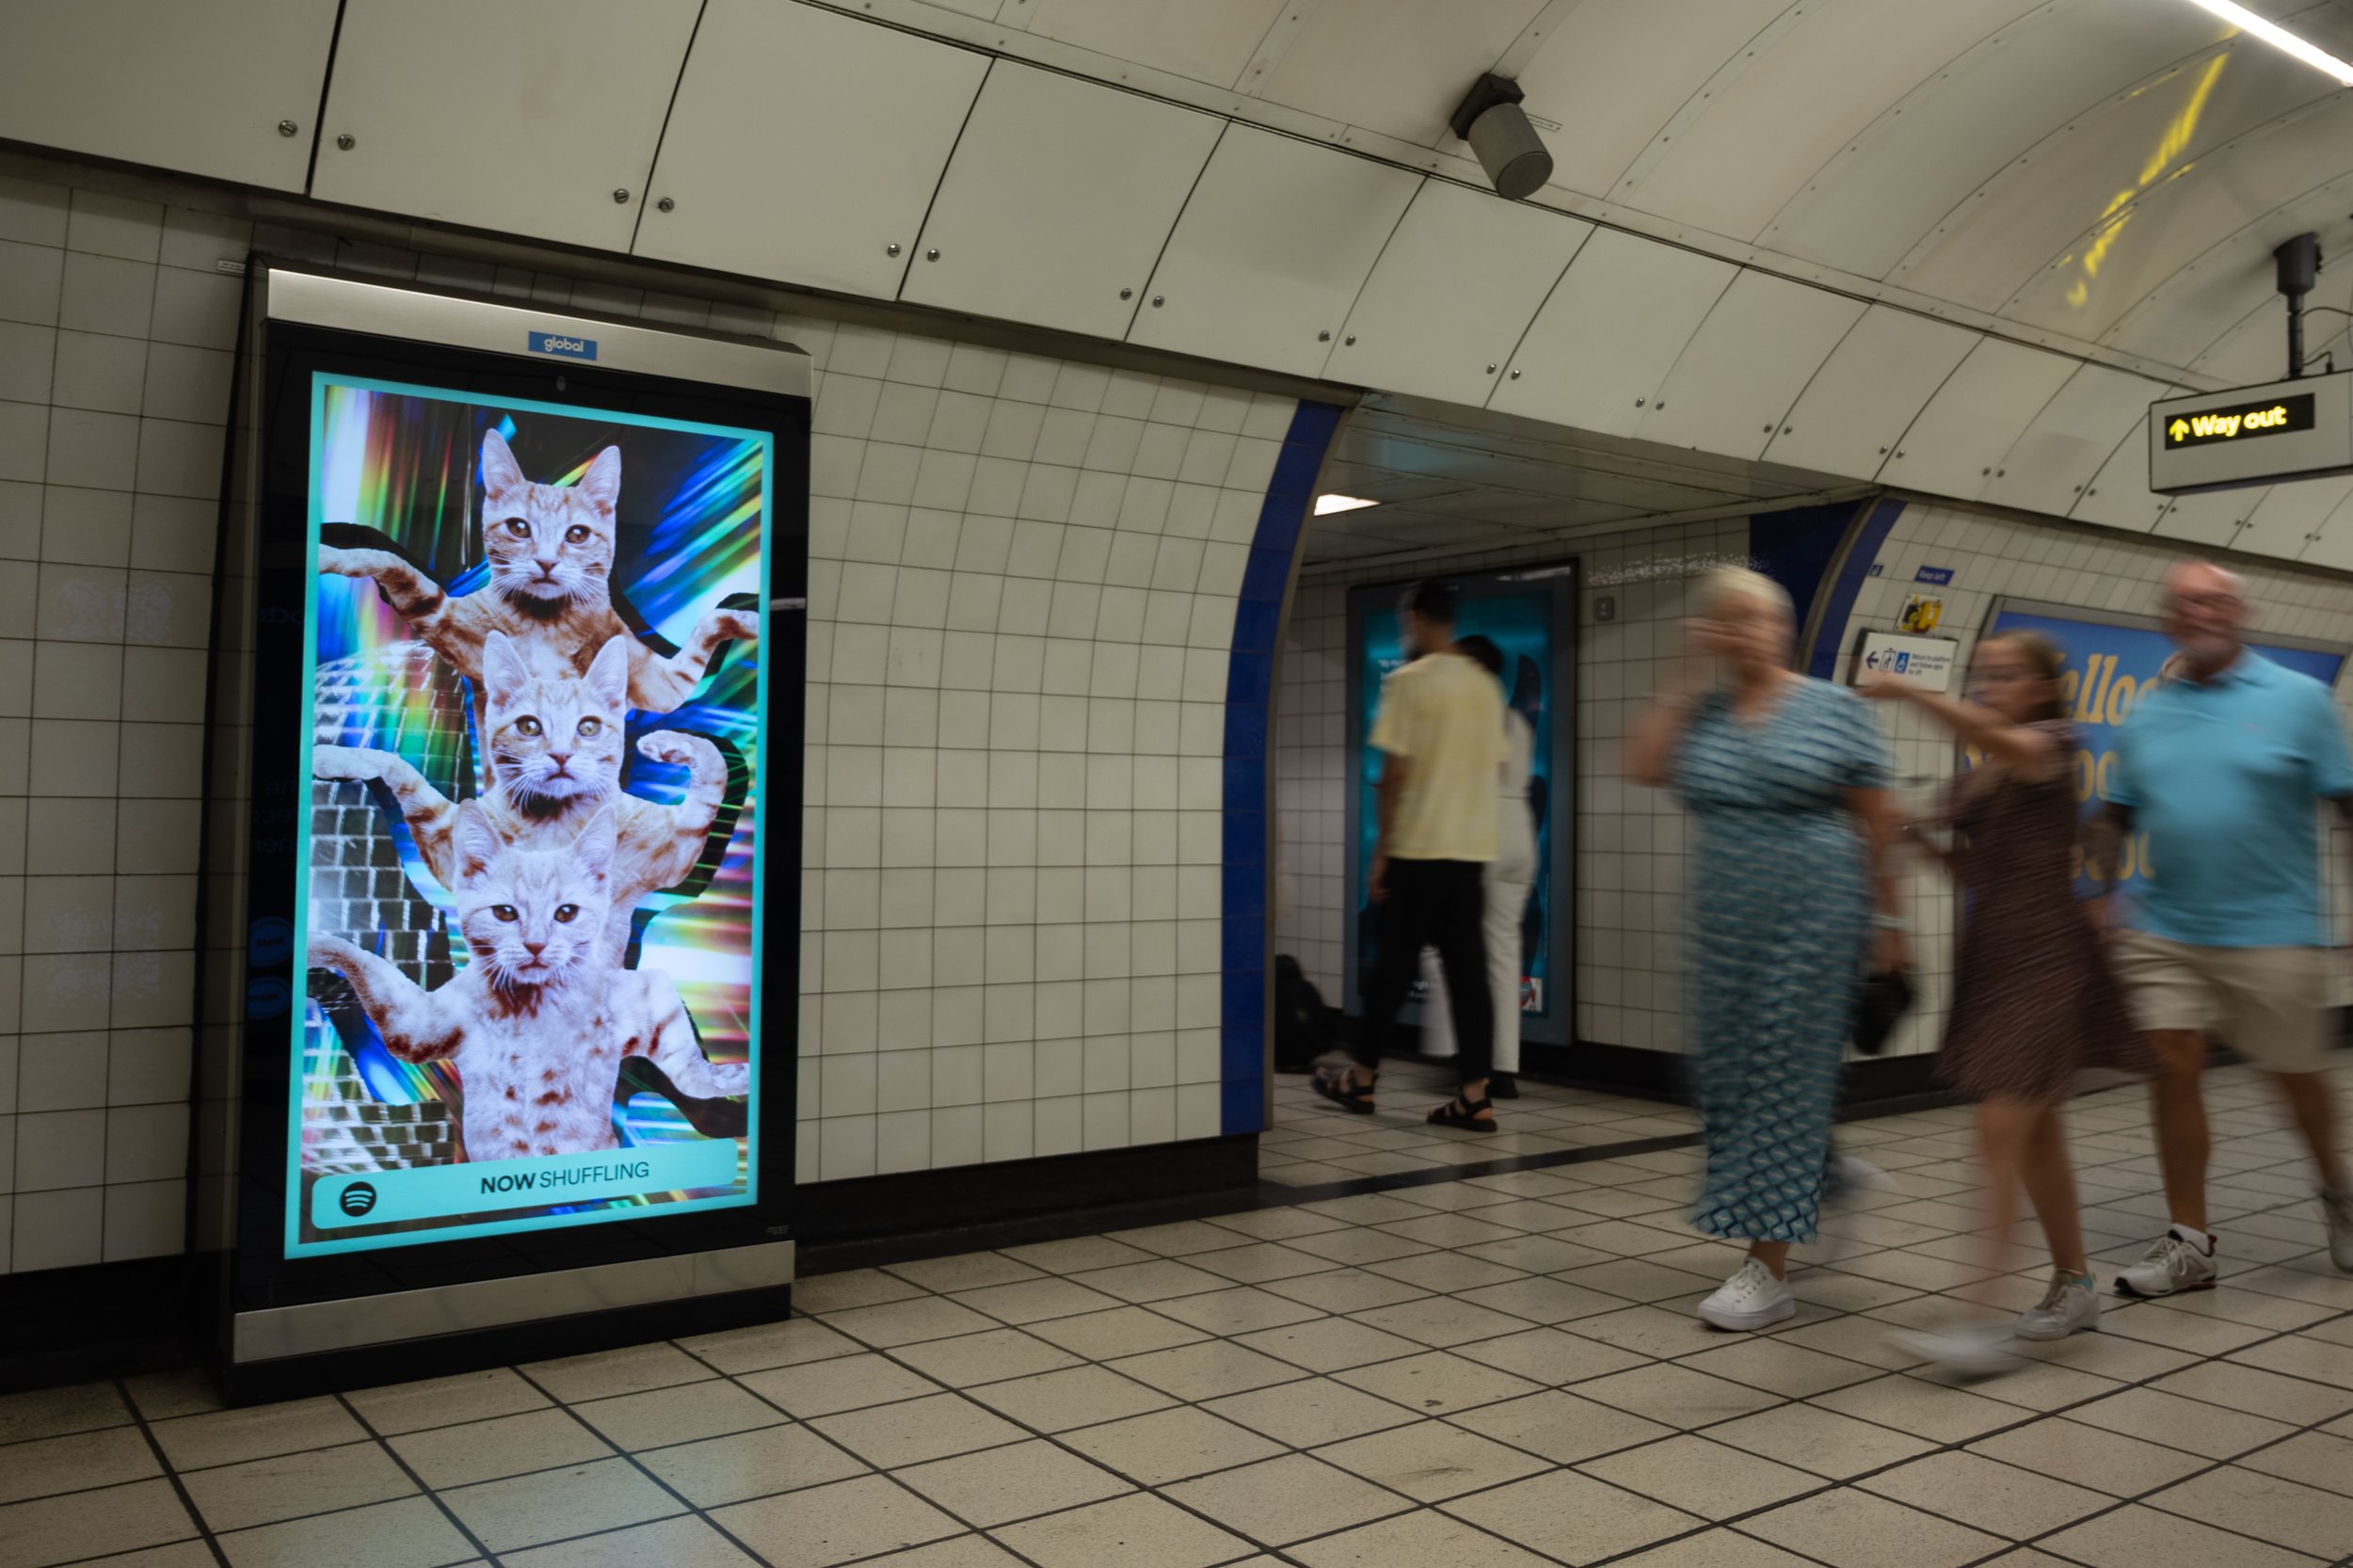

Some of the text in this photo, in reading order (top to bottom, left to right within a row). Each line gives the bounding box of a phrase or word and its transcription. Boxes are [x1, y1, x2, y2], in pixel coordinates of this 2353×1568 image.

[544, 336, 584, 352] global
[2191, 406, 2287, 437] Way out
[1918, 568, 1946, 582] Keep left
[1912, 652, 1927, 661] Return
[481, 1161, 649, 1193] NOW SHUFFLING
